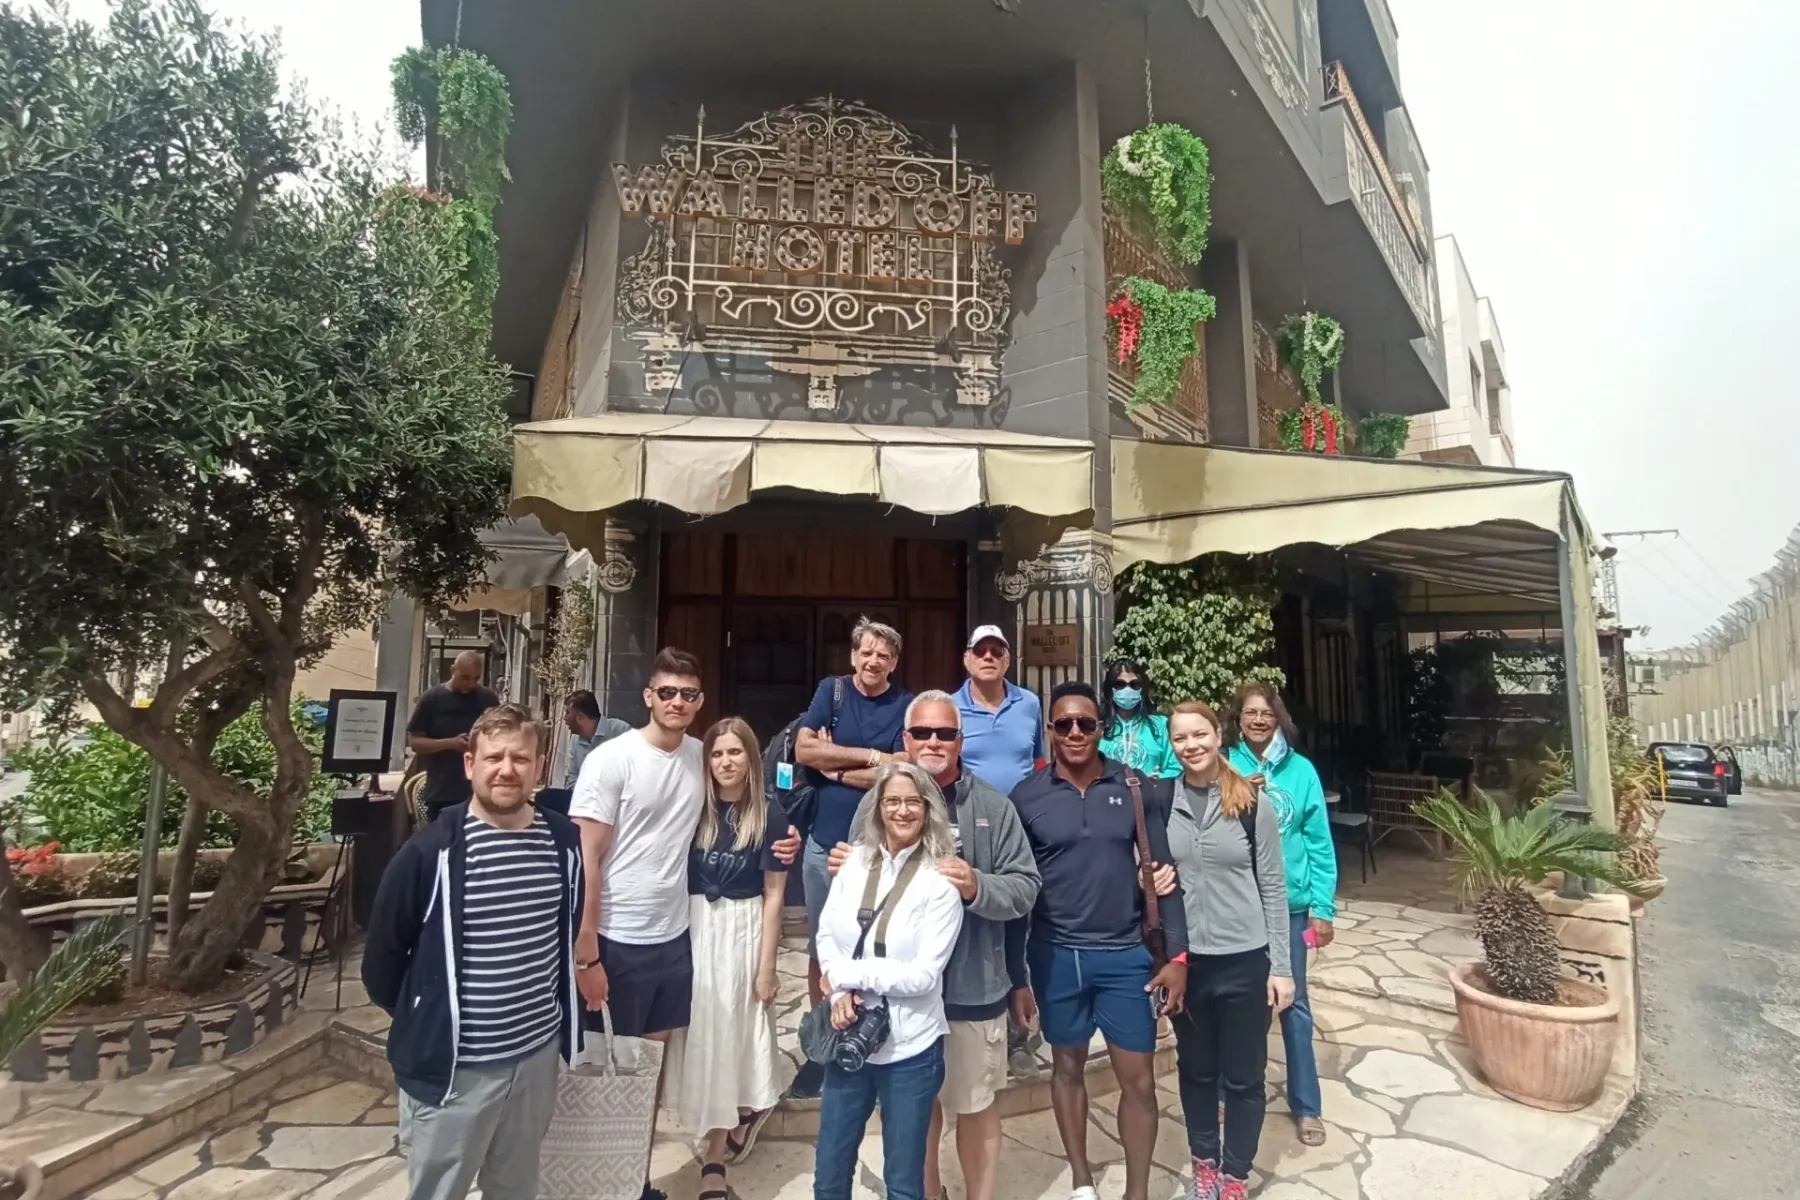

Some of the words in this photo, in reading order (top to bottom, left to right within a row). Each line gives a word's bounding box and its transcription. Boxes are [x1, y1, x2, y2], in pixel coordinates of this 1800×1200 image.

[778, 133, 877, 177] THE
[611, 162, 898, 229] WALLED
[912, 185, 1037, 244] OFF
[730, 222, 933, 285] HOTEL
